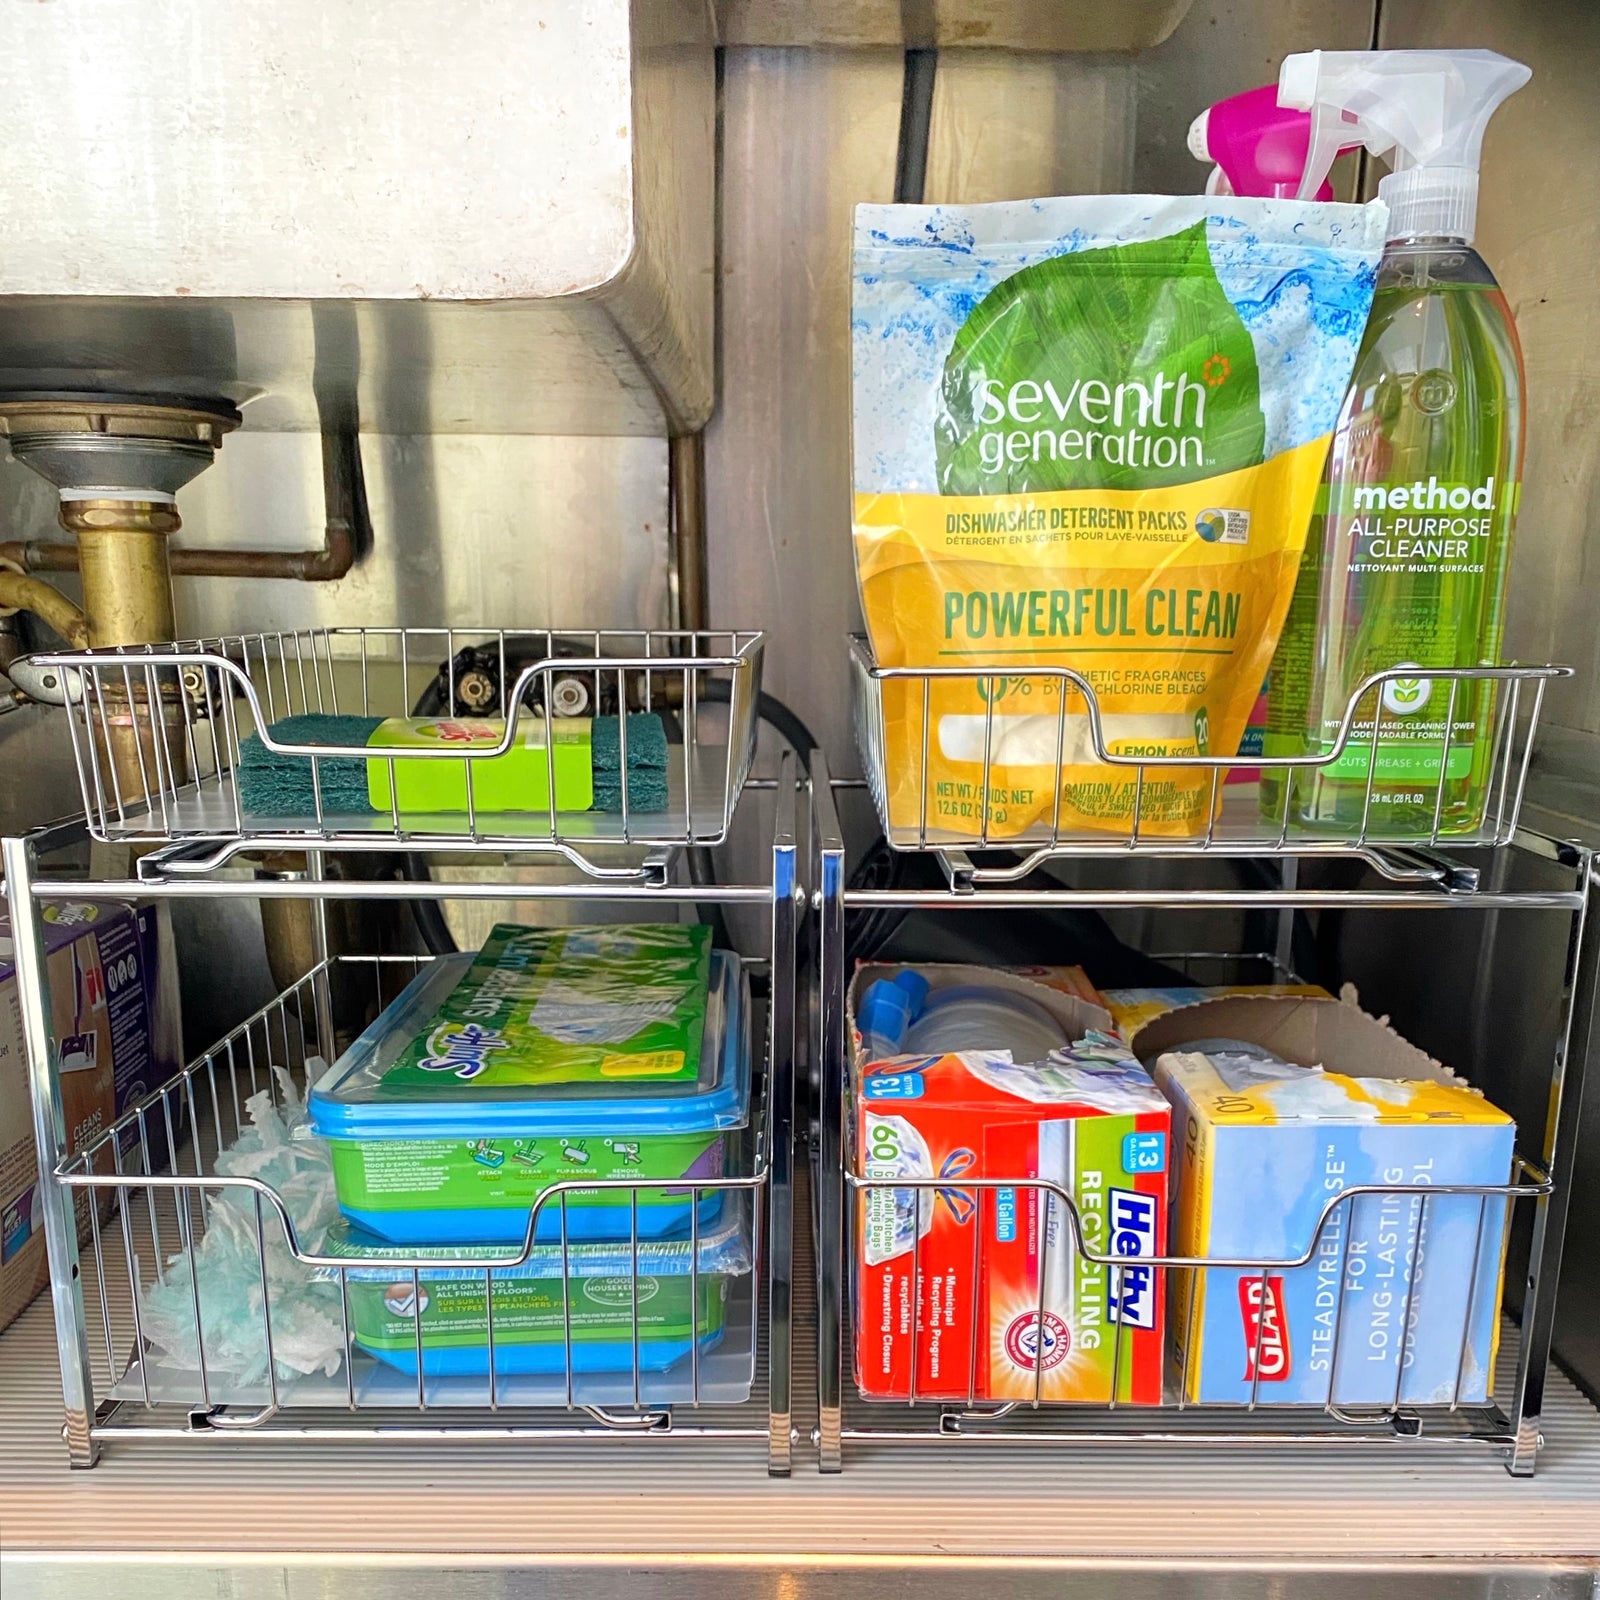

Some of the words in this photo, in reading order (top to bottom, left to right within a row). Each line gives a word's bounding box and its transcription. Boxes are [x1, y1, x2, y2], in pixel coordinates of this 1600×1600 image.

[979, 371, 1206, 428] seventh
[979, 428, 1205, 475] generation
[1353, 476, 1496, 511] method
[945, 508, 1047, 535] DISHWASHER
[1050, 507, 1135, 530] DETERGENT
[1138, 510, 1188, 531] PACKS
[1347, 518, 1492, 537] ALL-PURPOSE
[1009, 534, 1023, 544] EN
[1026, 532, 1072, 544] SACHETS
[1075, 531, 1103, 542] POUR
[1106, 532, 1188, 543] LAVE-VAISSELLE
[1369, 539, 1469, 558] CLEANER
[1347, 564, 1405, 573] NETTOYANT
[1408, 564, 1437, 573] MULTI
[1439, 564, 1485, 573] SURFACES
[944, 588, 1136, 640] POWERFUL
[1144, 589, 1242, 639] CLEAN
[1124, 670, 1207, 682] FRAGRANCES
[1095, 683, 1164, 695] CHLORINE
[1324, 720, 1343, 728] WIT
[1405, 721, 1447, 730] CLEANING
[1451, 722, 1476, 730] OWER
[1417, 731, 1456, 739] FORMUA
[1115, 745, 1167, 757] LEMON
[1338, 757, 1367, 767] CUTS
[1374, 758, 1412, 768] REASE
[1424, 758, 1455, 768] GRIE
[936, 781, 954, 797] NET
[957, 783, 971, 799] WT
[979, 786, 1008, 804] PIDS
[1011, 790, 1034, 805] NET
[1064, 782, 1112, 796] CAUTION
[1404, 794, 1413, 804] FL
[937, 800, 958, 816] 12.6
[960, 802, 972, 817] OZ
[871, 1077, 901, 1096] 13
[1211, 1095, 1255, 1114] 40
[73, 1107, 102, 1141] CLEANS
[871, 1125, 898, 1161] 60
[1129, 1137, 1137, 1169] GALLON
[1138, 1137, 1159, 1167] 13
[999, 1188, 1012, 1200] 13
[884, 1198, 894, 1215] Tall
[999, 1202, 1013, 1238] Gallon
[871, 1224, 883, 1248] Bags
[884, 1217, 894, 1253] Kitchen
[1080, 1170, 1102, 1350] RECYCLING
[1115, 1198, 1152, 1322] Hefty
[1346, 1240, 1369, 1291] FOR
[435, 1283, 458, 1292] SAFE
[475, 1281, 505, 1290] WOD
[436, 1290, 454, 1299] ALL
[500, 1301, 551, 1310] PLANCHERS
[881, 1275, 893, 1332] Drawstring
[899, 1276, 911, 1335] recyclables
[929, 1276, 942, 1327] Recycling
[946, 1275, 956, 1326] Municipal
[1247, 1282, 1285, 1375] GLAD
[882, 1334, 892, 1374] Closure
[929, 1328, 941, 1379] Programs
